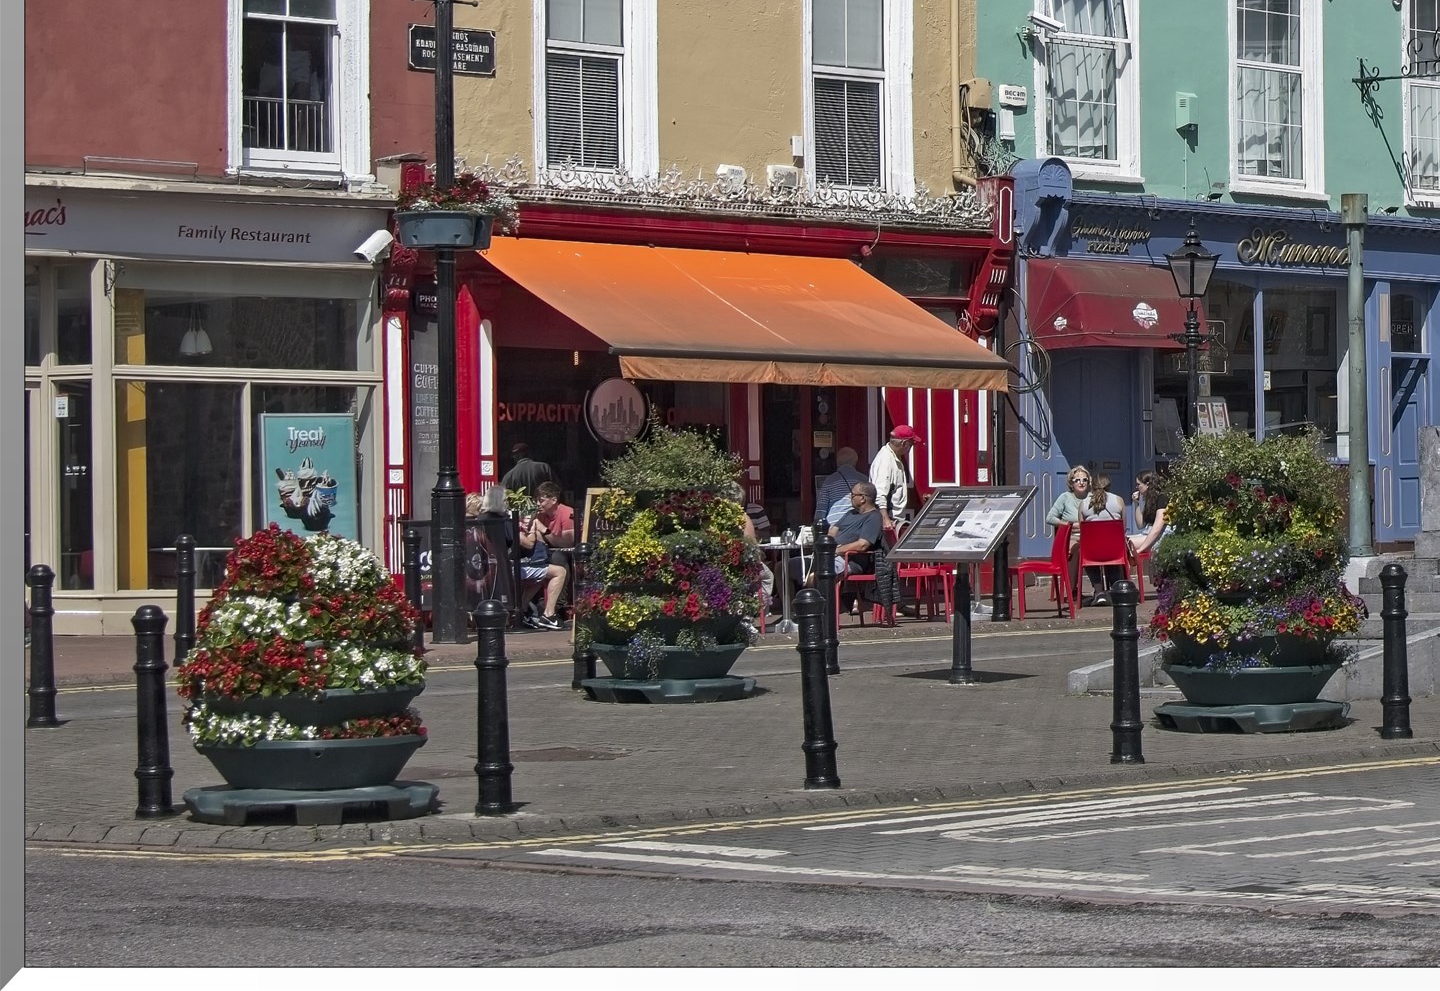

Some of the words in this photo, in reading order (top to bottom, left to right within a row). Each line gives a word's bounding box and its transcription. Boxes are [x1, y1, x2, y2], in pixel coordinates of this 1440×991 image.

[453, 52, 484, 63] ASEMENT
[178, 225, 227, 243] Family
[230, 227, 312, 244] Restaurant
[1087, 240, 1129, 253] PIZZERIA
[497, 401, 582, 423] CUPPACITY
[287, 426, 324, 441] Treat
